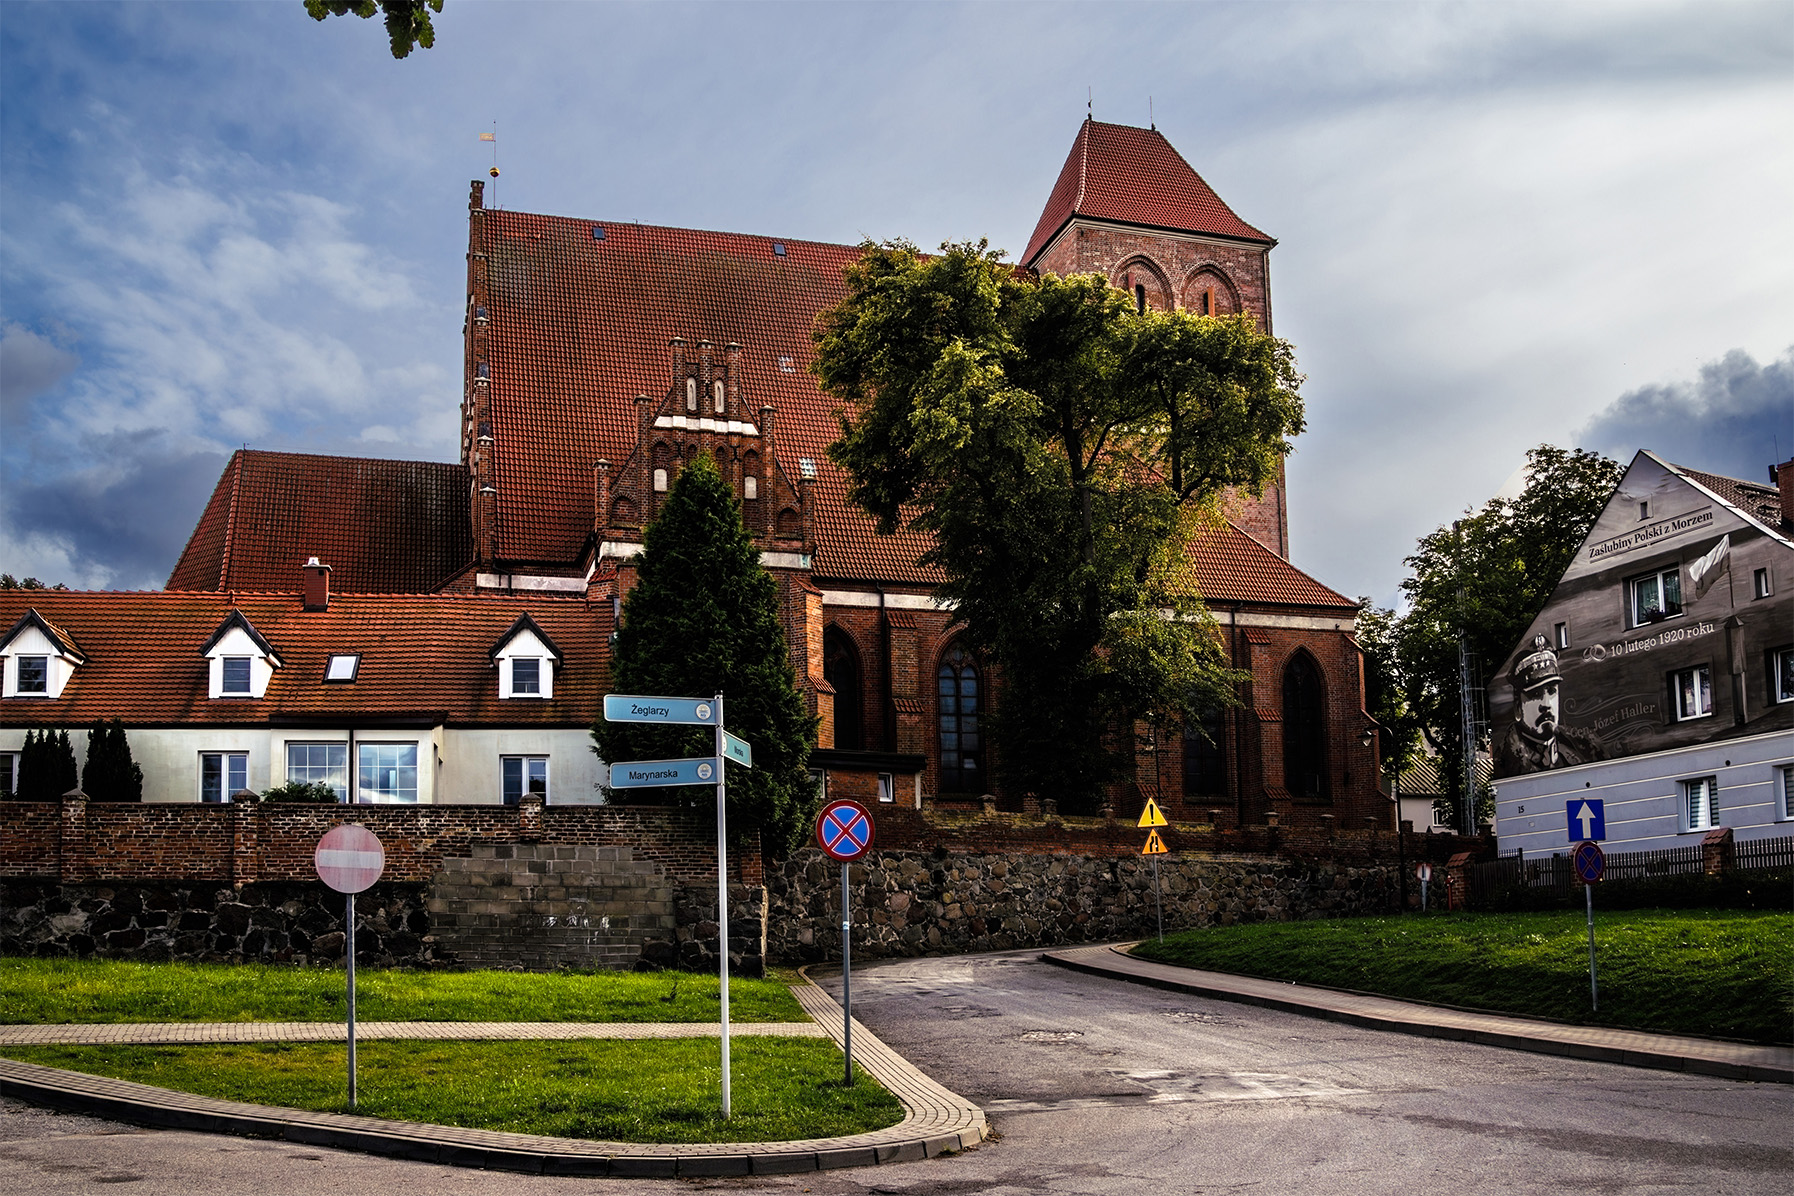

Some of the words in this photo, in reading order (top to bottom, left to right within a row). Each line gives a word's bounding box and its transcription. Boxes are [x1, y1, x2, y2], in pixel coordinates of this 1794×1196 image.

[1589, 537, 1633, 559] Zaślubiny
[1634, 525, 1663, 544] Polski
[1664, 525, 1670, 533] z
[1671, 511, 1713, 531] Morzem
[1611, 644, 1623, 657] 10
[1624, 638, 1657, 652] lutego
[1659, 628, 1685, 645] 1920
[1686, 622, 1715, 638] roku
[631, 704, 670, 718] Żeglarzy
[1593, 710, 1619, 731] Józef
[1620, 703, 1655, 720] Haller
[629, 769, 678, 782] Marynarska
[1518, 805, 1525, 814] 15
